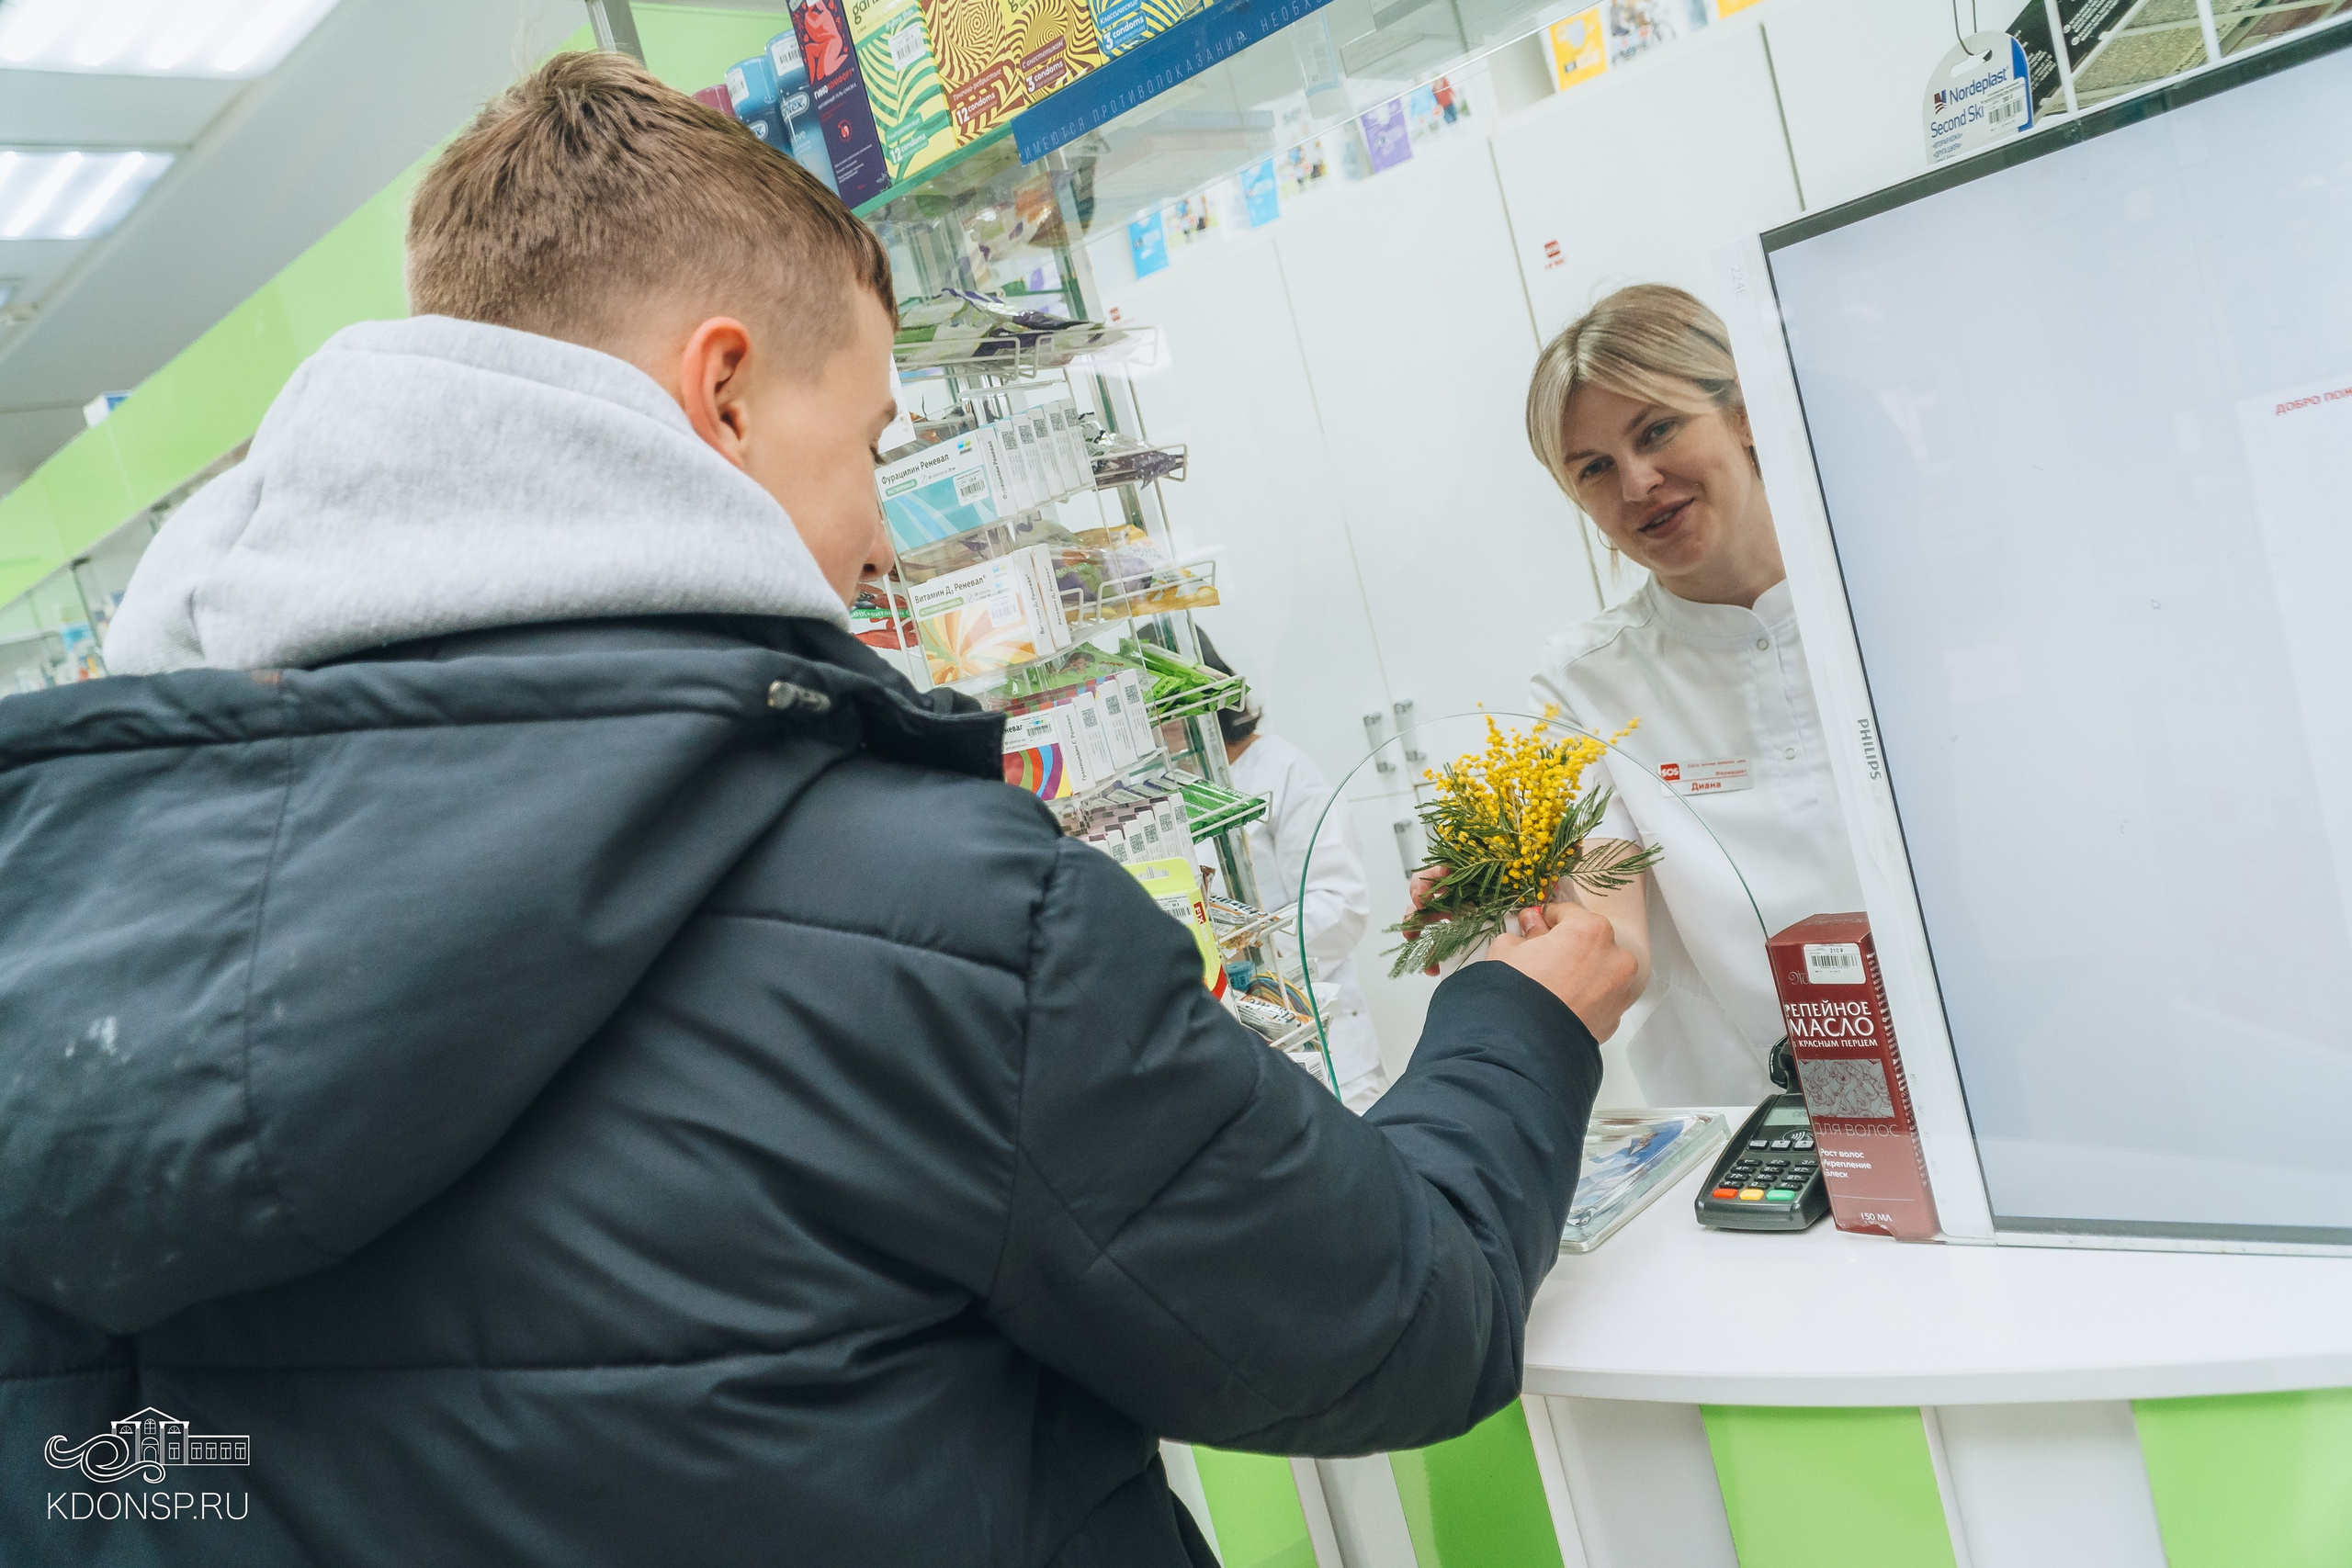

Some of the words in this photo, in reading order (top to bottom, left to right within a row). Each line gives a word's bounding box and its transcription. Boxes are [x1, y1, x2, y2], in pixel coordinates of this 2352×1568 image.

[1103, 33, 1114, 50] 3
[1113, 17, 1145, 38] condoms
[1026, 39, 1064, 66] анестетиком
[1025, 75, 1035, 93] 3
[1035, 61, 1065, 82] condoms
[1950, 68, 2007, 105] Nordeplast
[956, 107, 970, 125] 12
[967, 93, 996, 113] condoms
[1930, 108, 1966, 138] Second
[1968, 101, 1984, 122] Ski
[890, 147, 903, 164] 12
[901, 133, 926, 152] condoms
[1023, 118, 1086, 160] ИМЕЮТСЯ
[2276, 395, 2322, 416] ДОБРО
[2323, 387, 2352, 402] ПОЖ
[988, 440, 1000, 467] Реневал
[881, 466, 921, 485] Фурацилин
[920, 454, 950, 471] Реневал
[995, 467, 1008, 500] Фурацилин
[914, 590, 944, 604] Витамин
[1035, 613, 1045, 635] Витамин
[1066, 714, 1075, 740] Реневал
[1857, 718, 1882, 781] PHILIPS
[1660, 767, 1679, 777] SOS
[1690, 782, 1722, 791] Диана
[1784, 999, 1871, 1018] РЕПЕЙНОЕ
[1790, 1017, 1875, 1038] МАСЛО
[1799, 1039, 1839, 1048] КРАСНЫМ
[1841, 1038, 1879, 1047] ПЕРЦЕМ
[1815, 1122, 1843, 1136] ДЛЯ
[1845, 1123, 1901, 1138] ВОЛОС
[1820, 1148, 1838, 1159] Рост
[1839, 1151, 1865, 1159] волос
[1860, 1213, 1876, 1222] 150
[1877, 1213, 1893, 1222] МЛ
